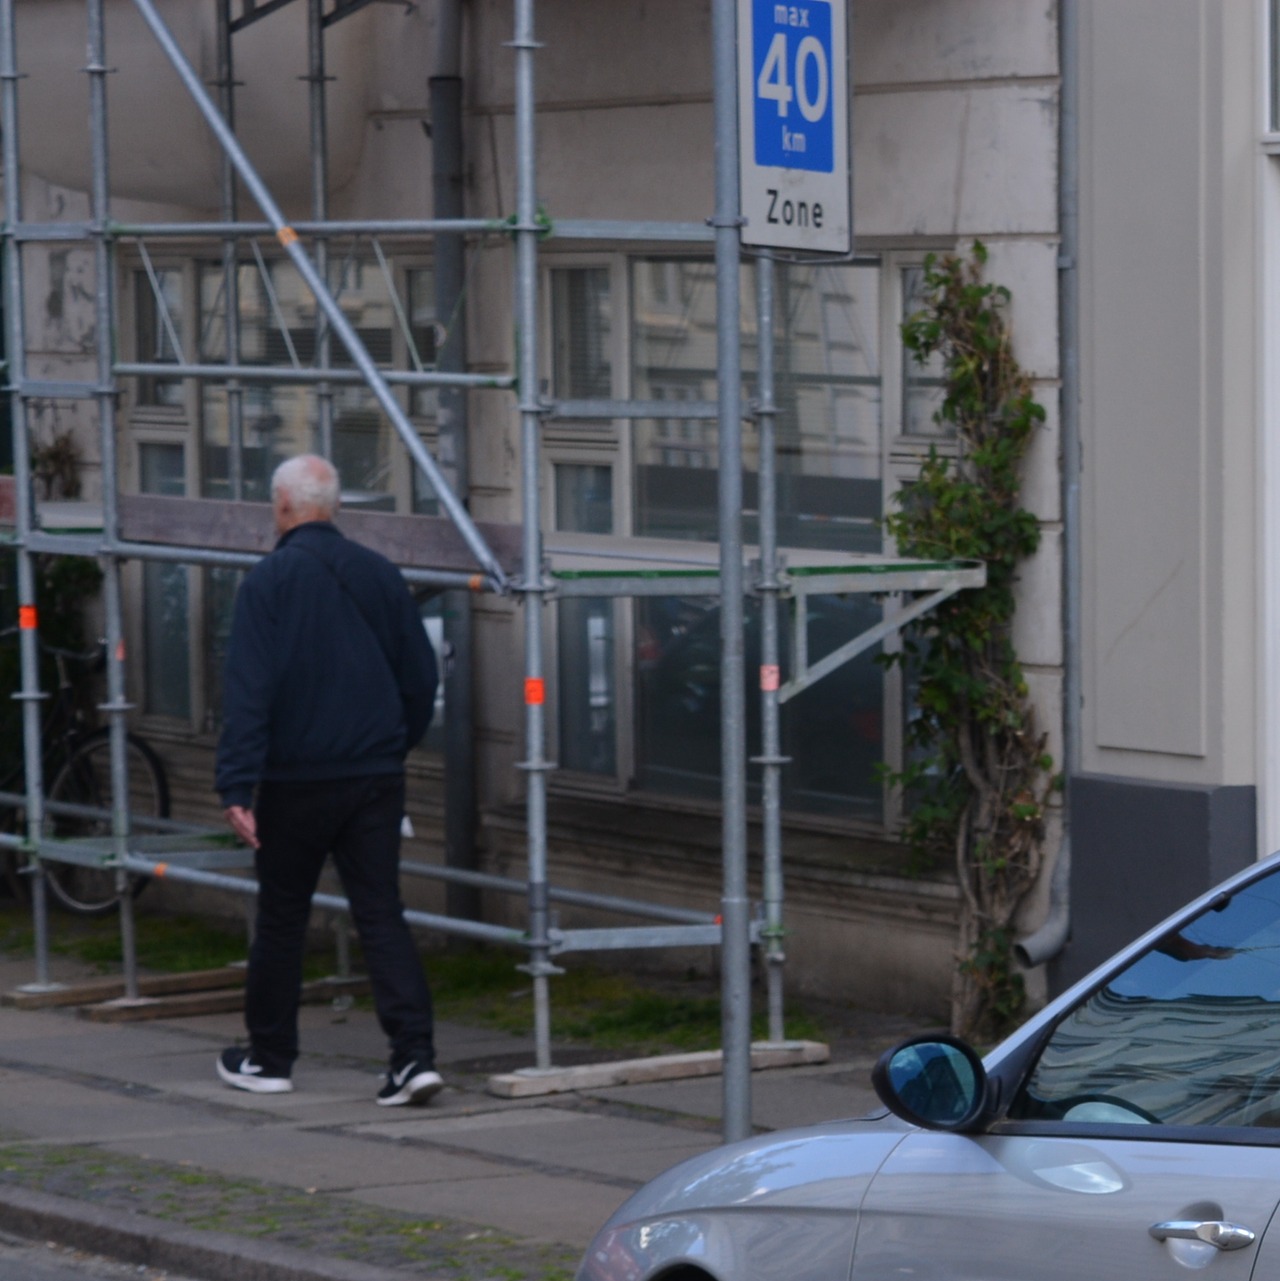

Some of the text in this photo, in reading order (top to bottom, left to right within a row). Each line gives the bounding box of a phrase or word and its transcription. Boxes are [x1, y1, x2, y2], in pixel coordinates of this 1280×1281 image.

[774, 4, 809, 28] max
[758, 32, 829, 122] 40
[782, 124, 806, 153] km
[766, 188, 823, 228] Zone
